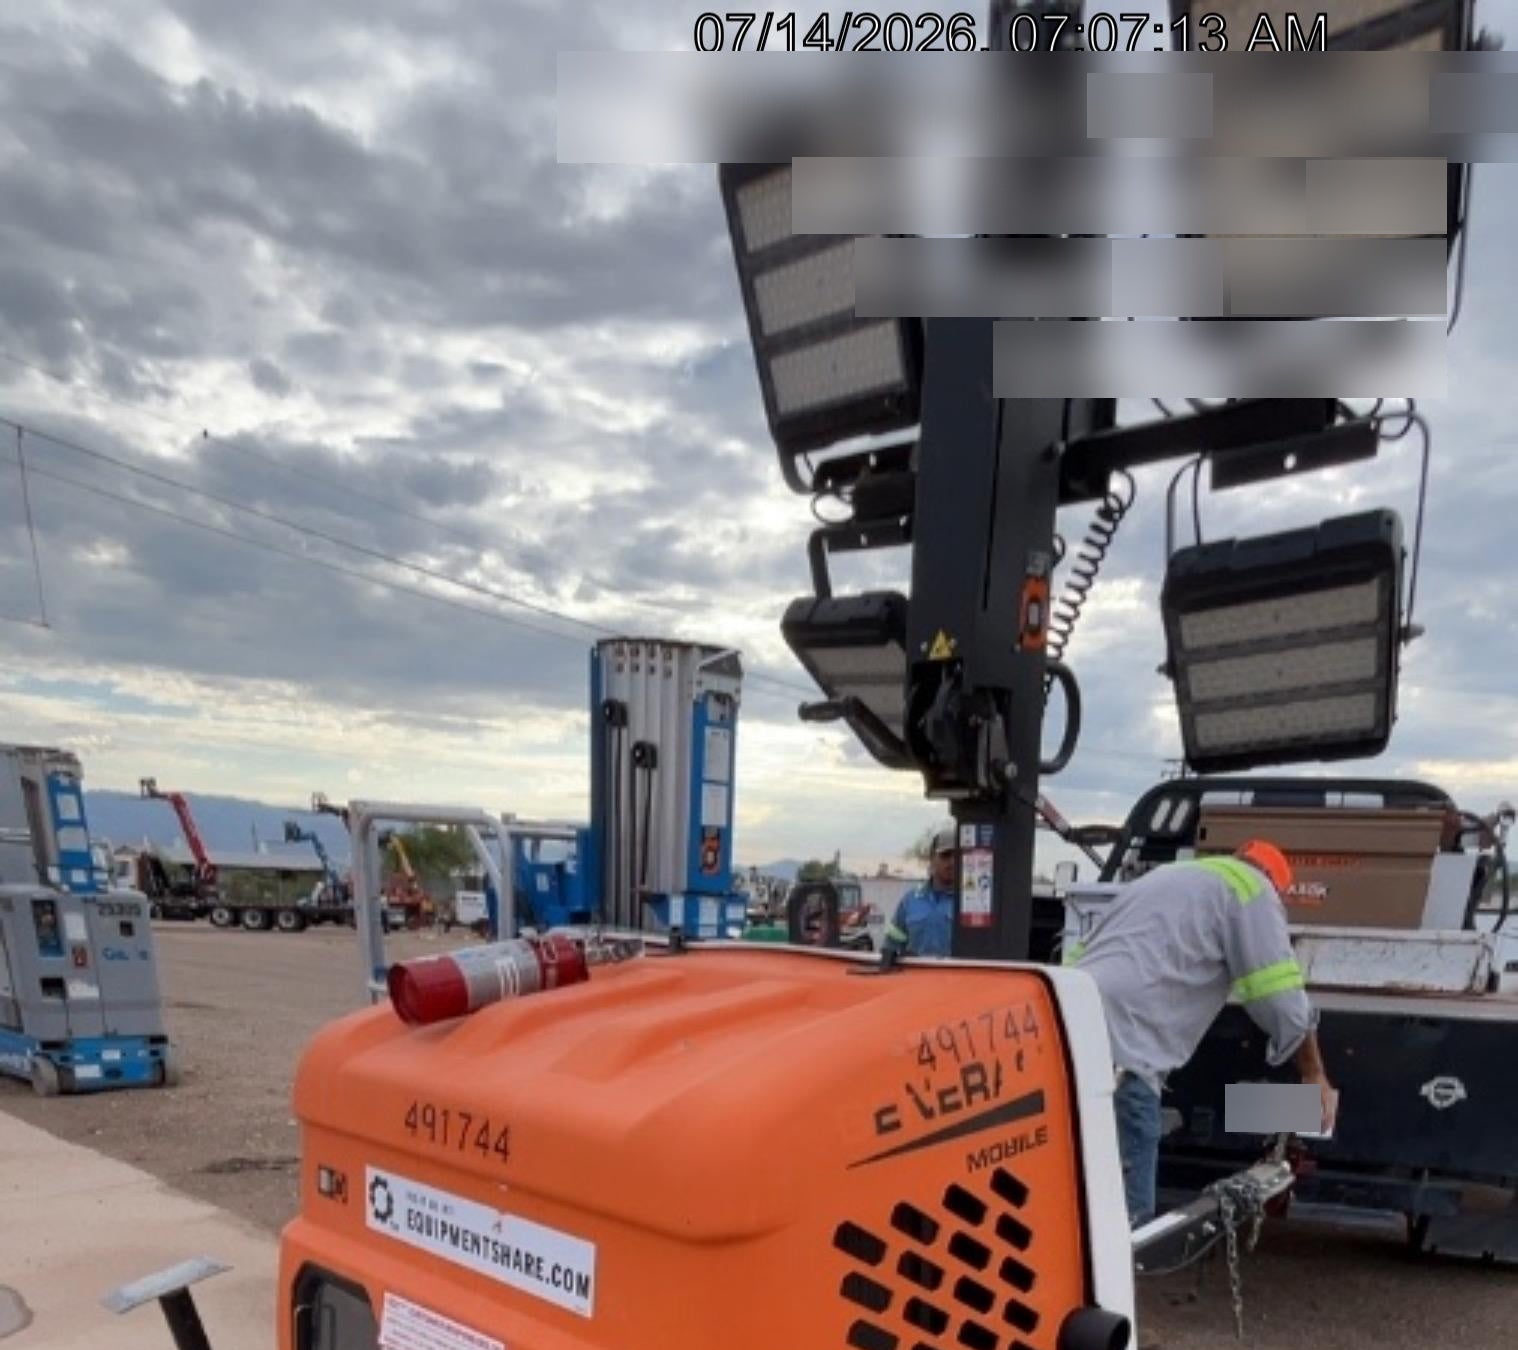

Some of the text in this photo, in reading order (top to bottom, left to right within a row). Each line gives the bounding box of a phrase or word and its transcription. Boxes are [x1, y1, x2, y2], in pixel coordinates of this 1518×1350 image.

[917, 1004, 1038, 1071] 491744
[404, 1100, 510, 1163] 491744
[965, 1125, 1048, 1173] MOBILE
[406, 1207, 592, 1300] EQUIPMENTSHARE.COM
